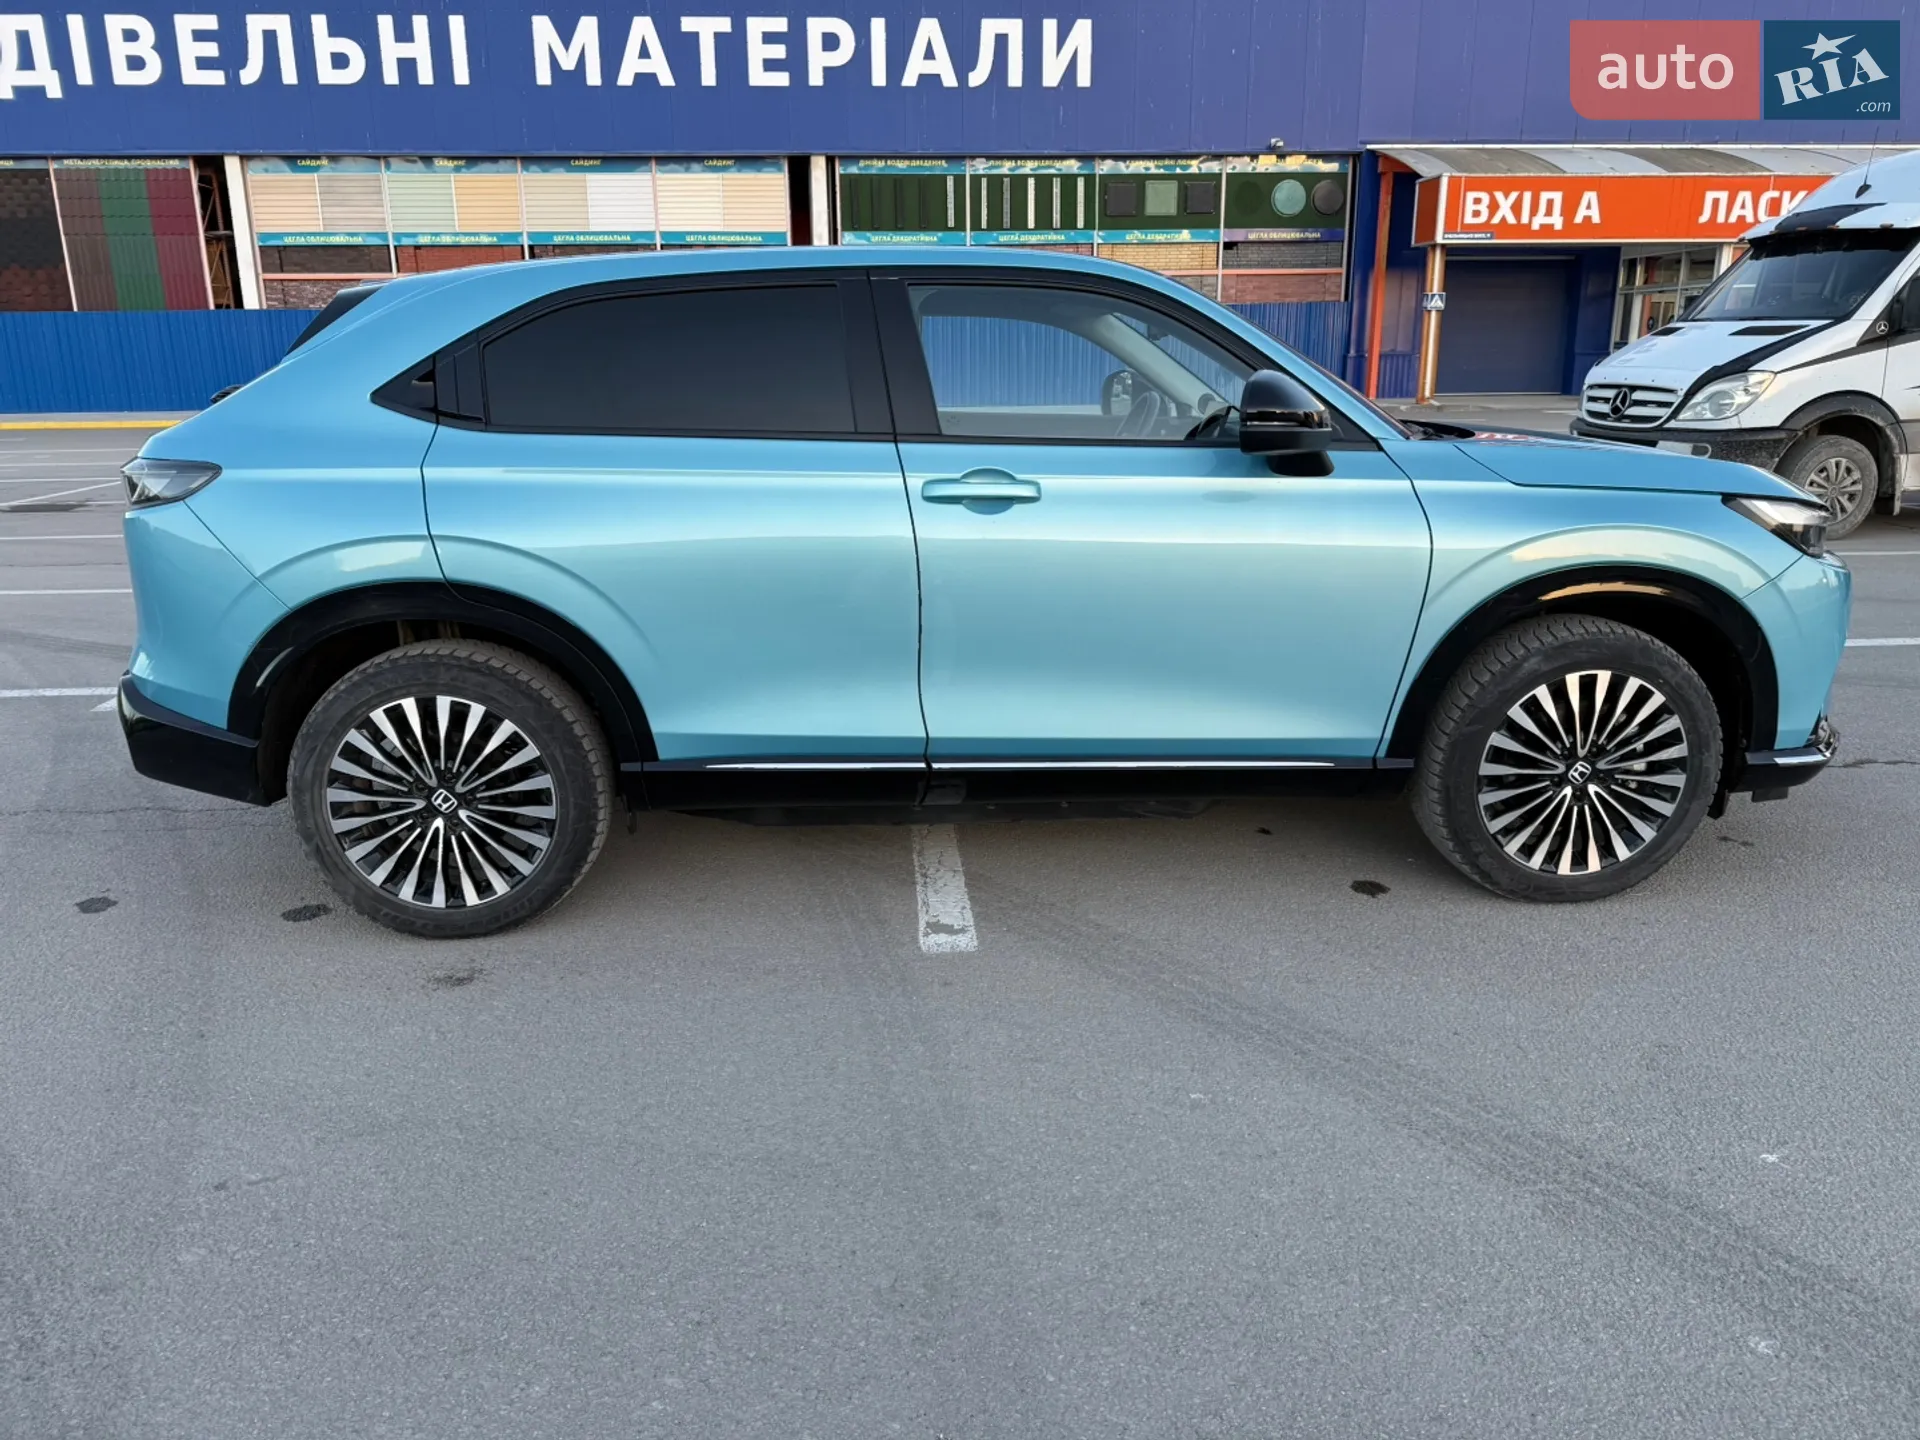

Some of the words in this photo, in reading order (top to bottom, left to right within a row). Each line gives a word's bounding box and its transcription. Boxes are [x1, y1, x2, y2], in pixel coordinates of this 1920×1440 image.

[531, 15, 1092, 87] МАТЕРІАЛИ
[1463, 190, 1564, 231] ВХІД
[1573, 190, 1601, 224] А
